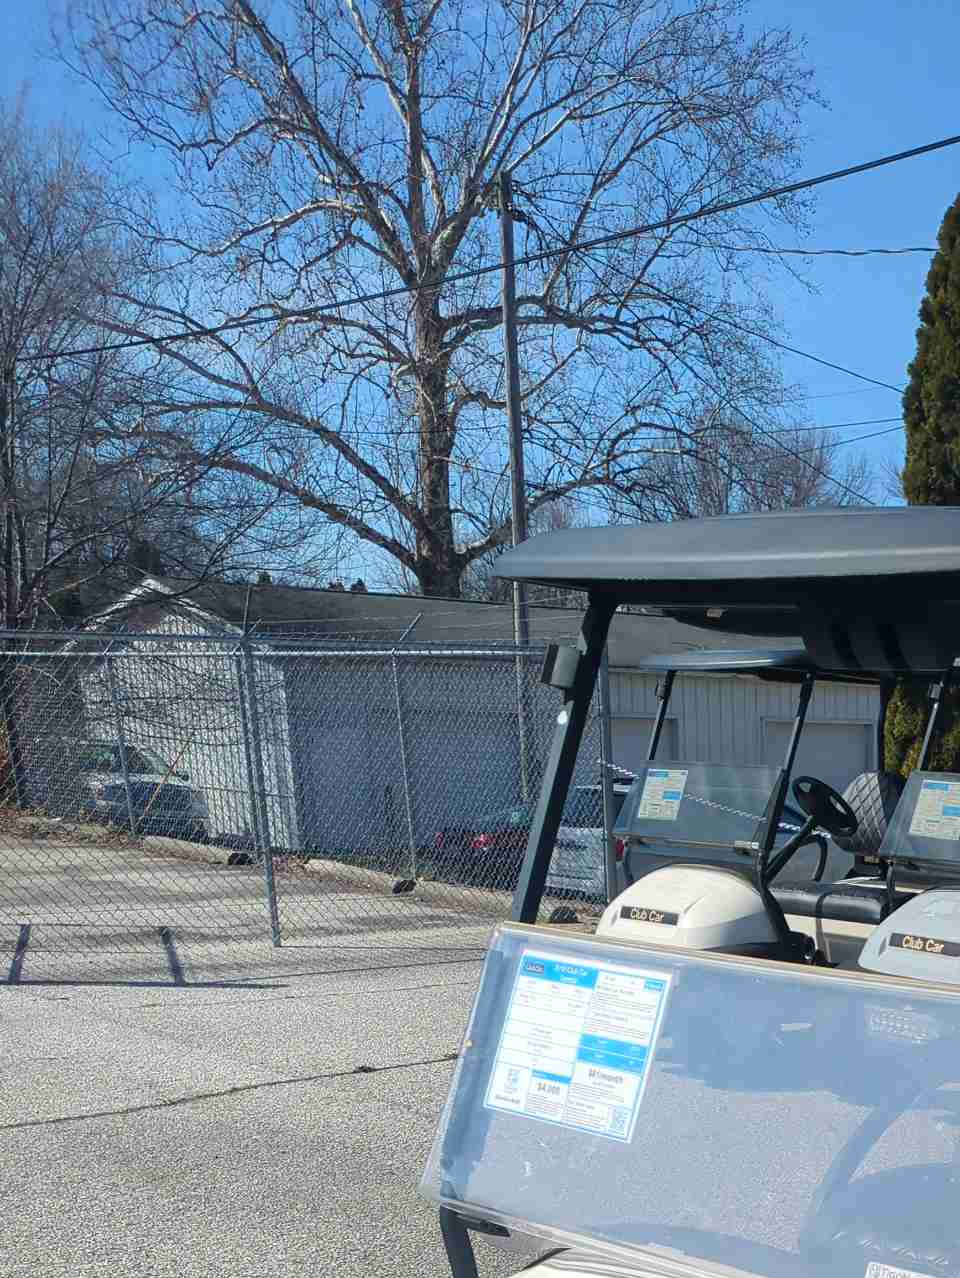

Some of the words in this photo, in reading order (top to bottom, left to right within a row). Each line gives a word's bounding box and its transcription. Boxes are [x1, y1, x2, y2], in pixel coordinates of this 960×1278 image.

[630, 907, 647, 921] Club
[648, 910, 665, 922] Car
[902, 935, 924, 950] Club
[925, 939, 945, 953] Car
